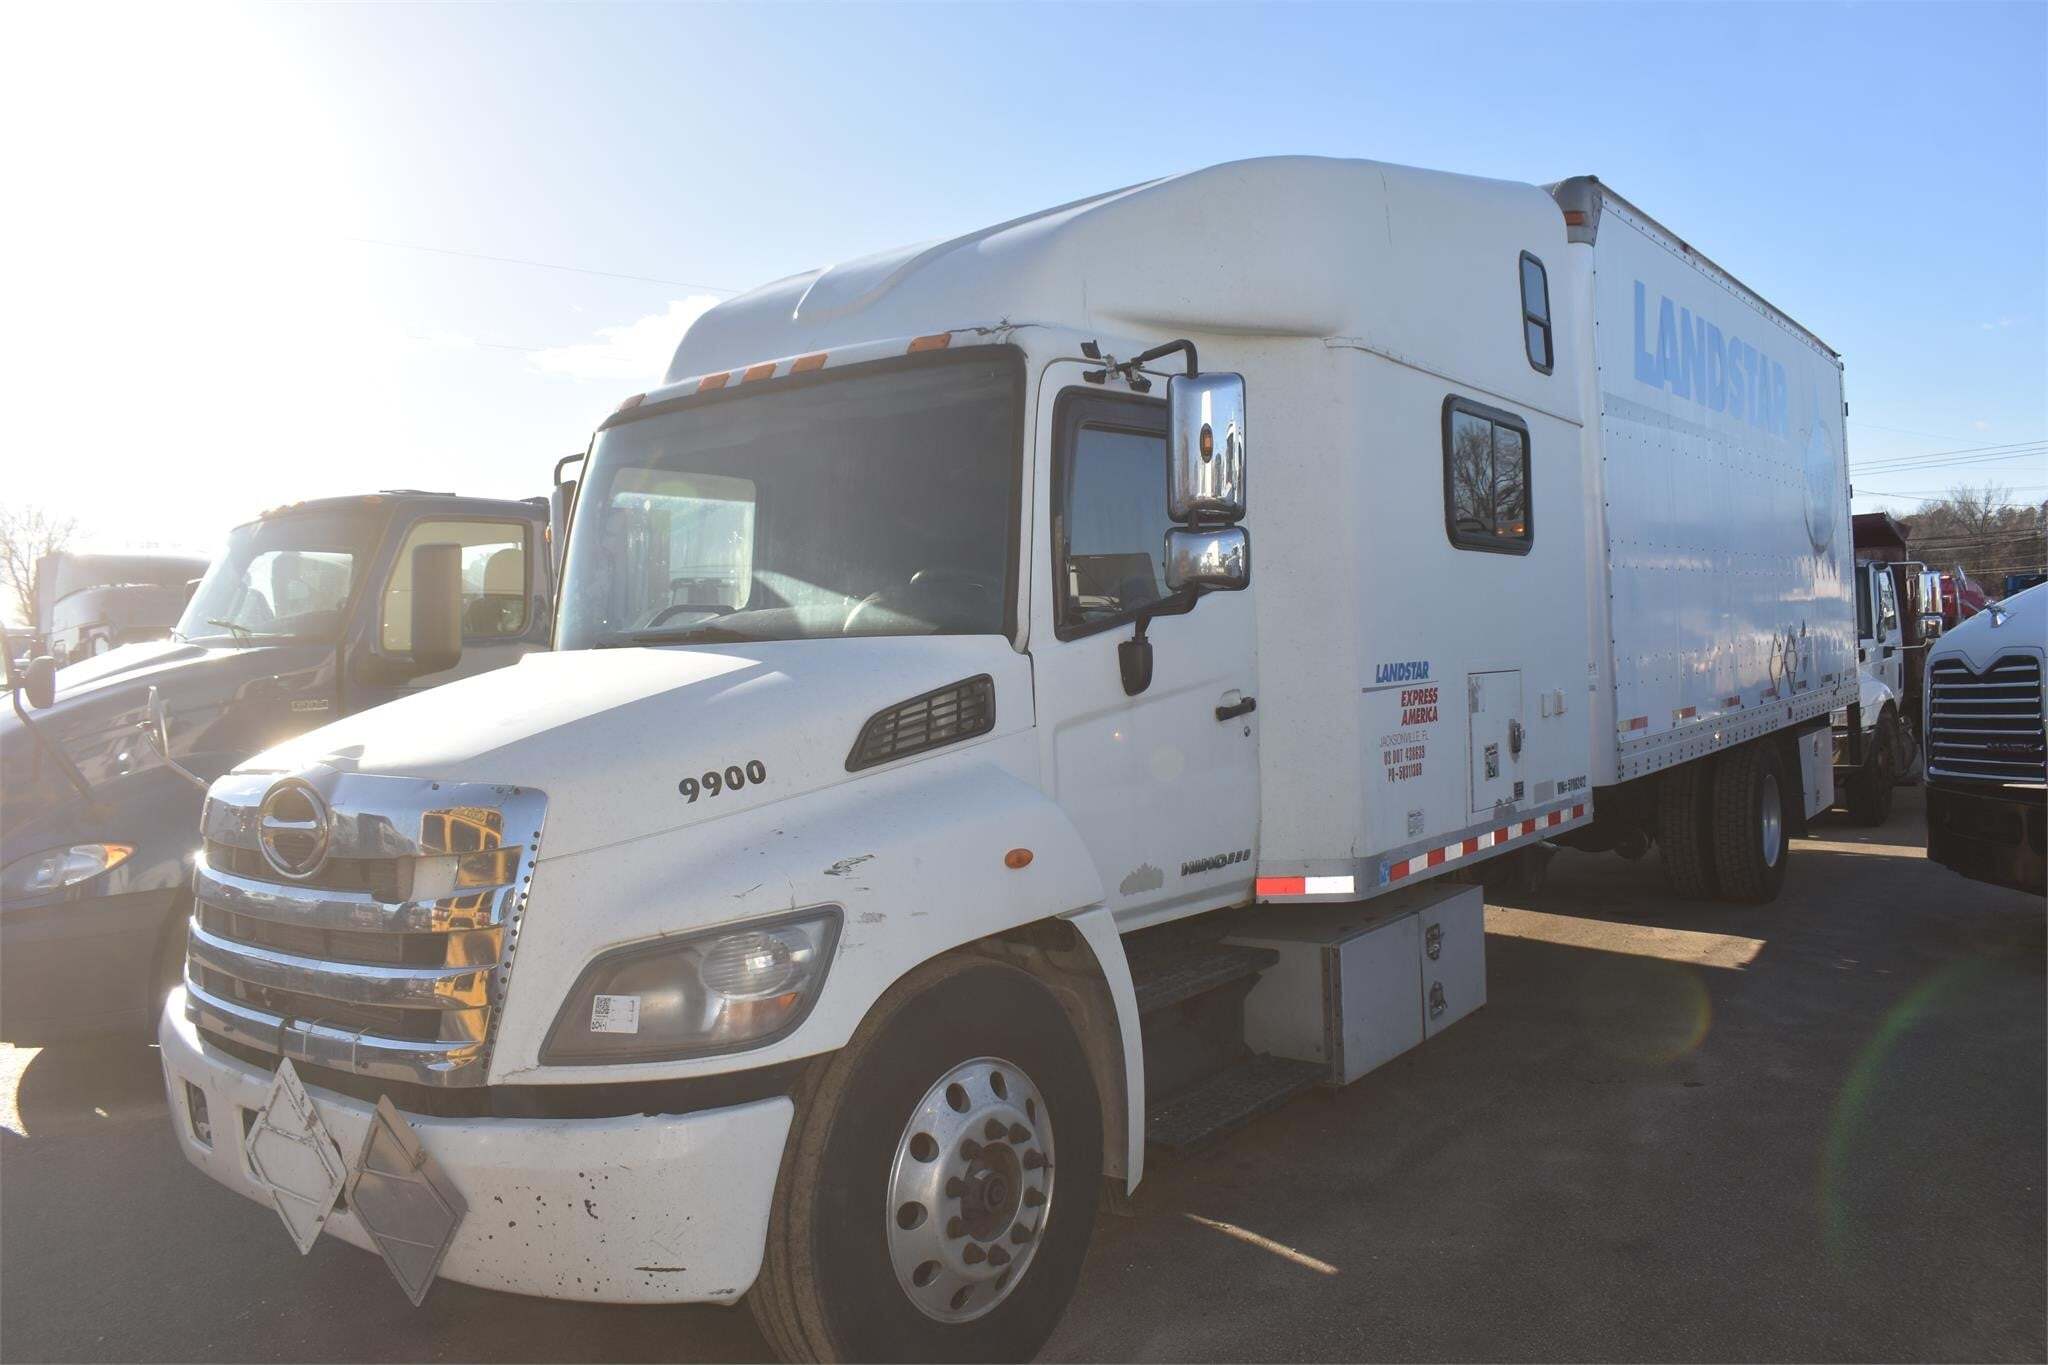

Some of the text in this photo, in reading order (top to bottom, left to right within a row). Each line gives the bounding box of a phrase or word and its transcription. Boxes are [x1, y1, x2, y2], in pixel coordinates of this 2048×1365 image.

[1634, 280, 1788, 440] LANDSTAR
[1375, 661, 1430, 683] LANDSTAR
[1401, 687, 1439, 707] EXPRESS
[1401, 706, 1439, 726] AMERICA
[679, 760, 767, 804] 9900
